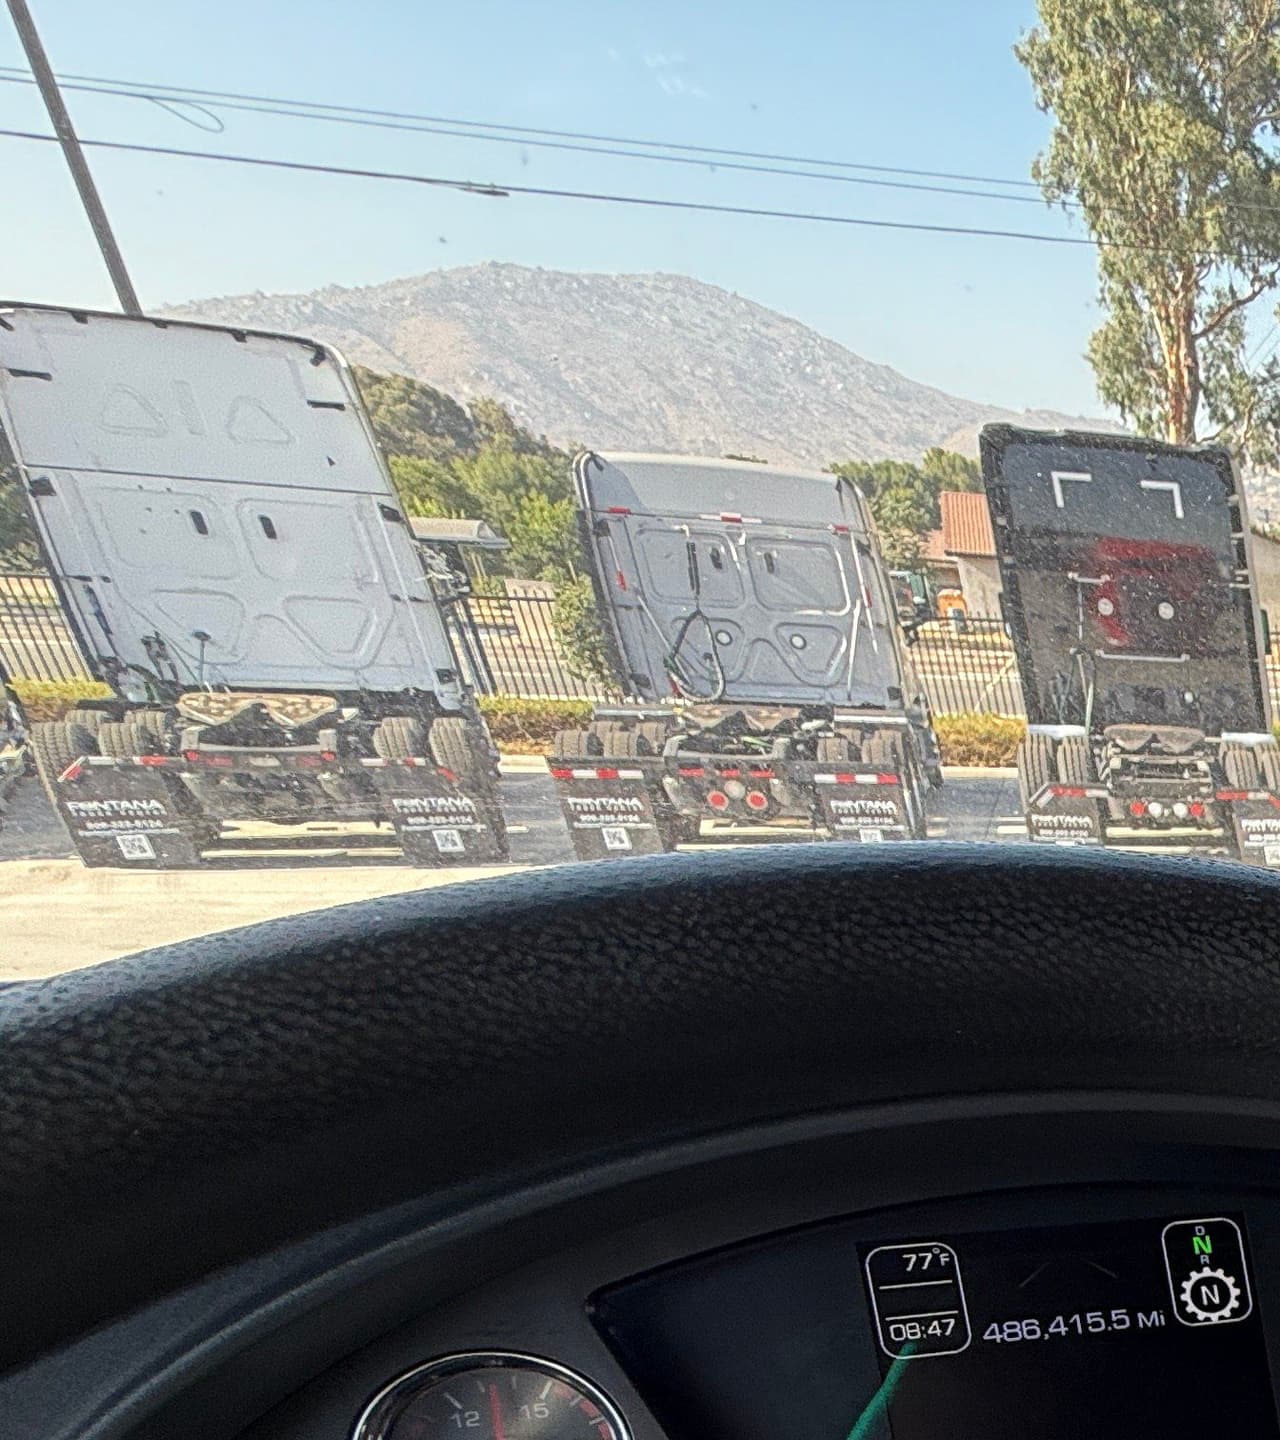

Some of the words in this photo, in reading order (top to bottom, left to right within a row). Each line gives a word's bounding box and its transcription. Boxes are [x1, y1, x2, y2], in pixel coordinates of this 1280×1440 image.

[1192, 1236, 1213, 1256] N
[1201, 1284, 1220, 1306] N
[889, 1317, 956, 1343] 08:47
[982, 1309, 1132, 1345] 486,415.5
[1137, 1310, 1166, 1330] Mi
[451, 1409, 482, 1430] 12
[520, 1401, 551, 1421] 15
